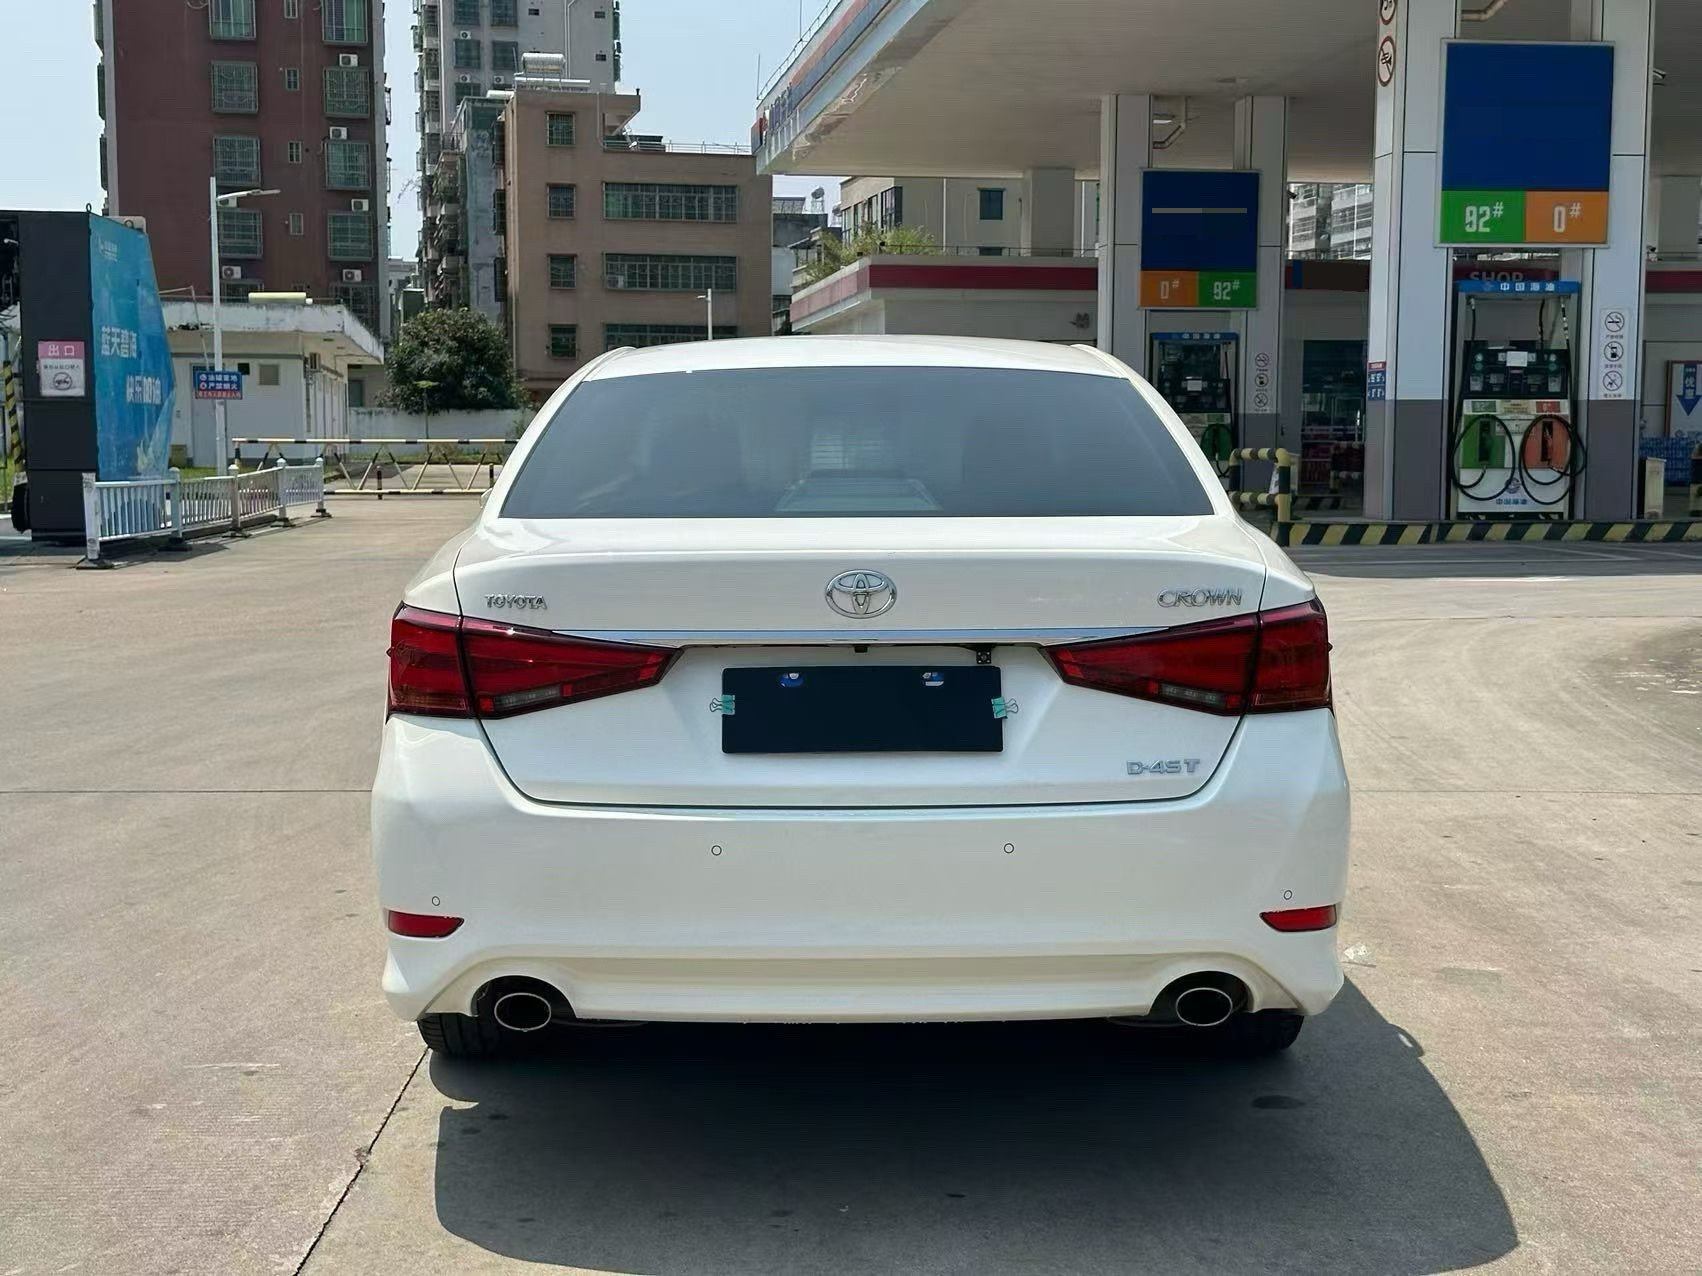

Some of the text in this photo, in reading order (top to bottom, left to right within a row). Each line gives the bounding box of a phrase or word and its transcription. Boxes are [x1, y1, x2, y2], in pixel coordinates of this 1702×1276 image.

[1465, 202, 1504, 233] 92#
[1553, 203, 1581, 233] 0#
[1160, 280, 1180, 299] 0#
[1213, 280, 1241, 300] 92#
[1500, 282, 1555, 291] 中国海油
[48, 344, 75, 356] 出口
[484, 594, 547, 609] TOYOTA
[1157, 589, 1241, 607] CROWN
